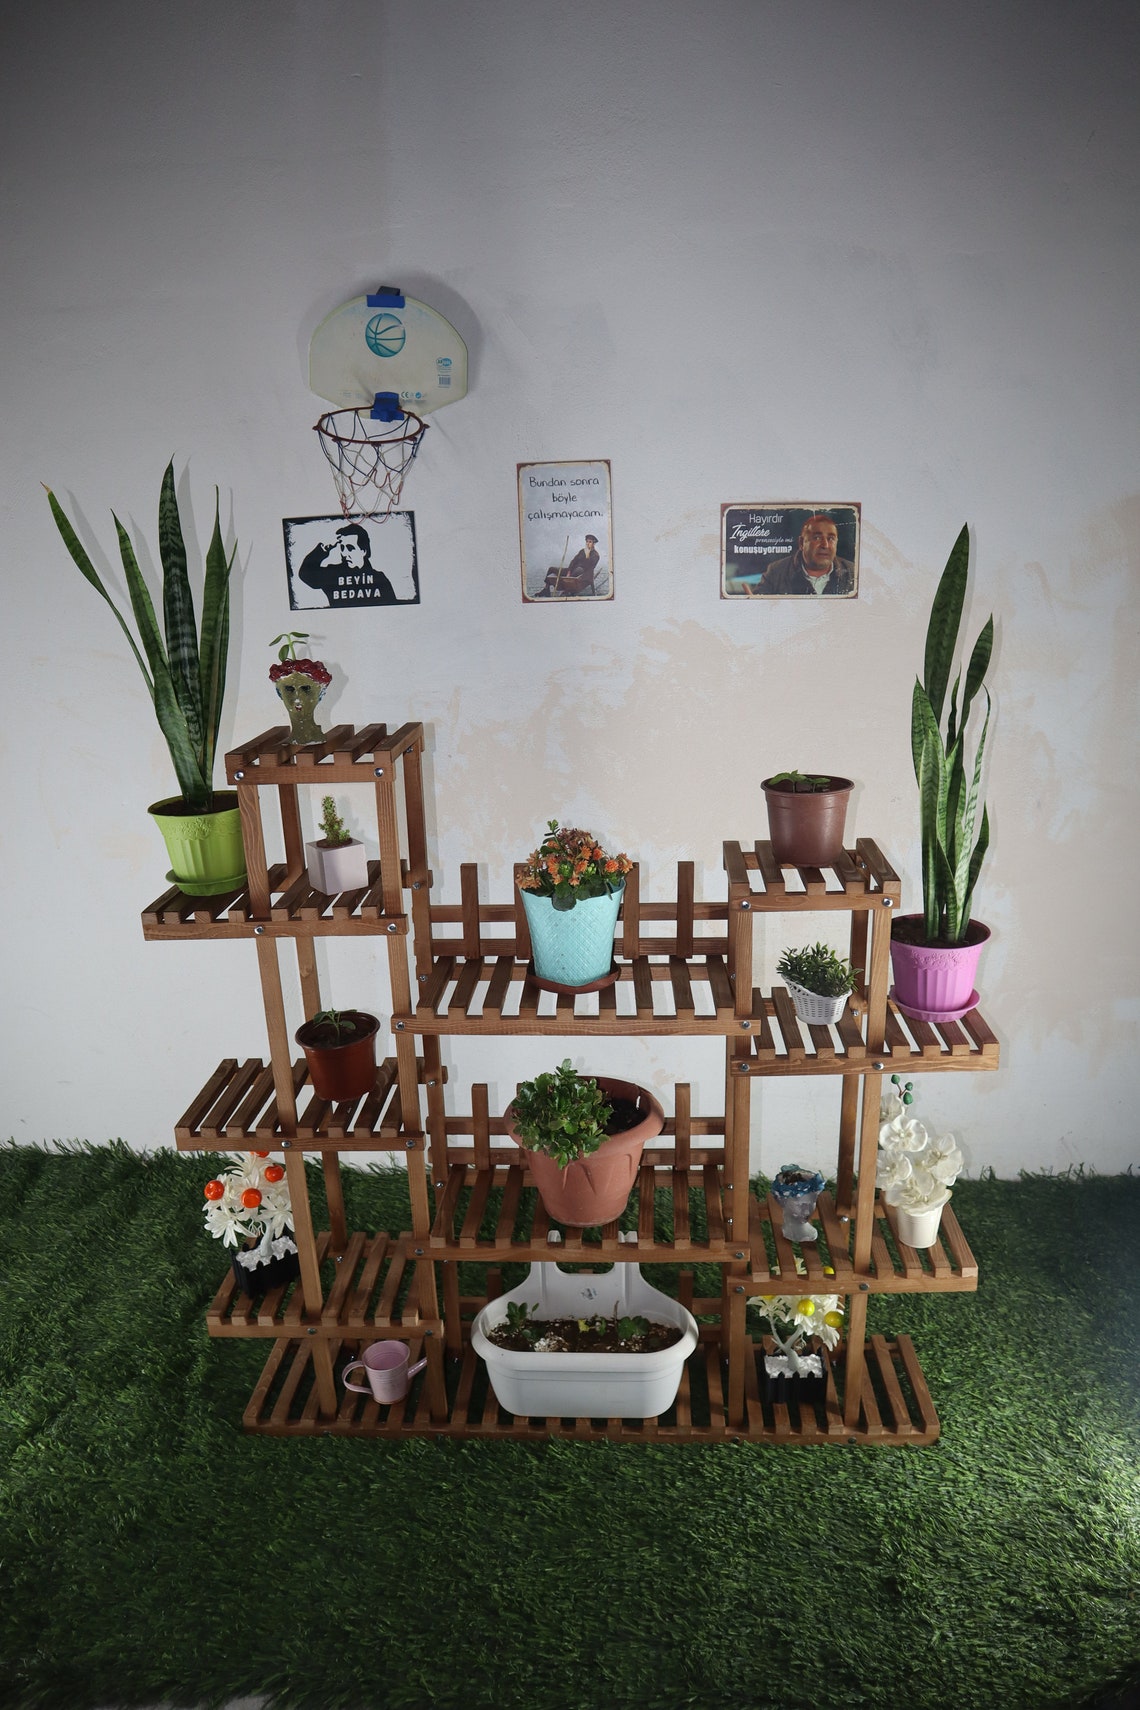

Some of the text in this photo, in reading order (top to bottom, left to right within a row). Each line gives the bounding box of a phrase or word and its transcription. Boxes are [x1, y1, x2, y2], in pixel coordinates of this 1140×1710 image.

[529, 476, 600, 487] Bundan sonra
[552, 492, 578, 504] böyle
[527, 509, 604, 521] çalışmayacam.
[749, 513, 784, 526] Hayırdır
[734, 545, 793, 555] konuşuyorum?
[338, 572, 374, 586] BEYİN
[333, 588, 381, 599] BEDAVA
